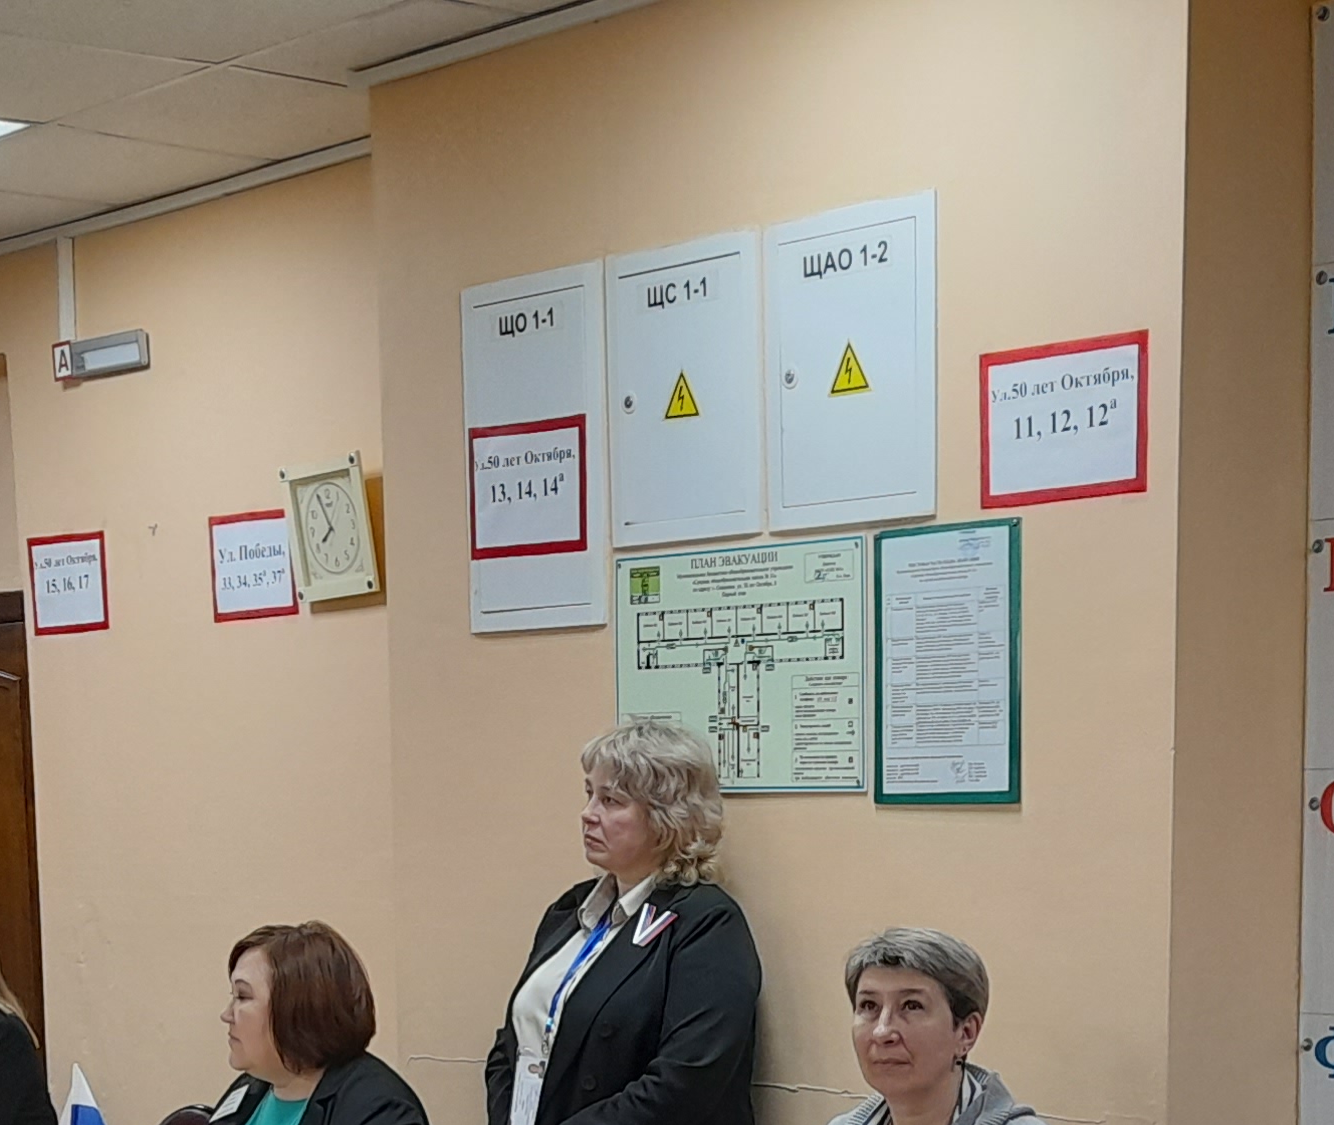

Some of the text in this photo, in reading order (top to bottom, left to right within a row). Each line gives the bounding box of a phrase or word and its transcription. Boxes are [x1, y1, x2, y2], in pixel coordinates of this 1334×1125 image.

[803, 240, 889, 280] ЩАО 1-2
[647, 276, 708, 309] ЩС 1-1
[499, 307, 555, 337] ЩО 1-1
[1031, 380, 1057, 396] лет
[1061, 367, 1135, 391] Октября,
[1014, 415, 1042, 441] 11,
[1050, 409, 1078, 435] 12,
[502, 455, 522, 467] лет
[525, 447, 575, 464] Октября,
[491, 483, 512, 505] 13,
[517, 479, 537, 502] 14,
[239, 543, 285, 561] Победы,
[691, 552, 779, 570] ПЛАН ЭВАКУАЦИИ
[79, 574, 89, 589] 17
